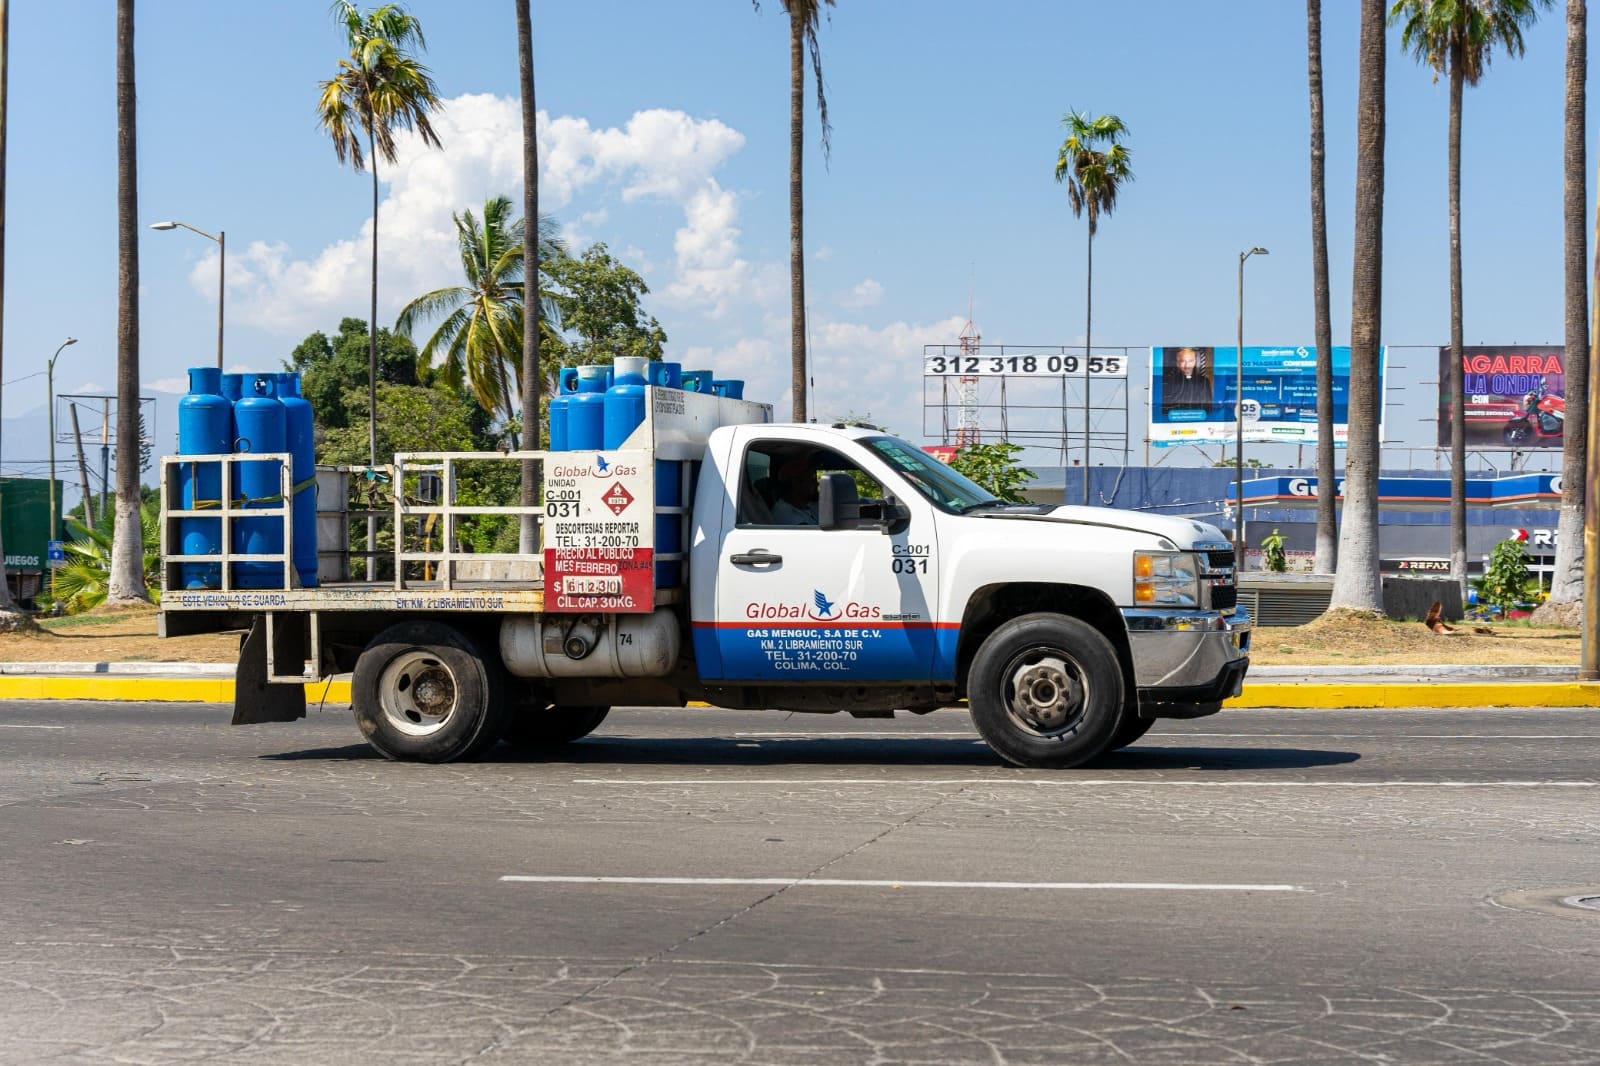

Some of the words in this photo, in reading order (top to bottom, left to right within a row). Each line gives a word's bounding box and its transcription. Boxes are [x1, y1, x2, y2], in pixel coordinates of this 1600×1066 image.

[932, 357, 980, 374] 312
[990, 356, 1037, 373] 318
[1048, 356, 1079, 373] 09
[1088, 357, 1120, 373] 55
[1463, 355, 1562, 374] AGARRA
[1465, 375, 1487, 394] LA
[1492, 375, 1541, 395] ONDA
[1472, 395, 1489, 404] CON
[554, 466, 592, 478] Global
[615, 465, 637, 475] Gas
[549, 479, 576, 487] UNIDAD
[546, 490, 581, 499] C-001
[547, 503, 580, 517] 031
[556, 523, 603, 534] DESCORTESIAS
[605, 522, 639, 534] REPORTAR
[556, 536, 581, 547] TEL:
[585, 536, 639, 547] 31-200-70
[555, 548, 585, 559] PRECIO
[587, 548, 597, 559] AL
[599, 548, 634, 559] PUBLICO
[892, 544, 929, 554] C-001
[4, 555, 39, 566] JUEGOS
[1410, 562, 1449, 570] REFAX
[555, 560, 574, 572] MES
[576, 562, 618, 574] FEBRERO
[892, 559, 927, 574] 031
[554, 581, 561, 592] $
[182, 595, 201, 607] ESTE
[242, 595, 253, 606] SE
[254, 594, 286, 606] GUARDA
[428, 598, 432, 608] 2
[433, 597, 485, 608] LIBRAMIENTO
[488, 597, 504, 608] SUR
[746, 603, 807, 618] Global
[846, 602, 881, 618] Gas
[620, 634, 632, 645] 74
[747, 630, 769, 638] GAS
[771, 630, 821, 639] MENGUC,
[824, 630, 841, 638] S.A
[844, 630, 859, 638] DE
[862, 630, 882, 638] C.V.
[761, 640, 777, 650] KM.
[778, 640, 784, 650] 2
[785, 639, 843, 650] LIBRAMIENTO
[845, 640, 863, 650] SUR
[765, 651, 793, 661] TEL.
[797, 651, 857, 661] 31-200-70
[775, 662, 821, 671] COLIMA,
[823, 662, 850, 670] COL.
